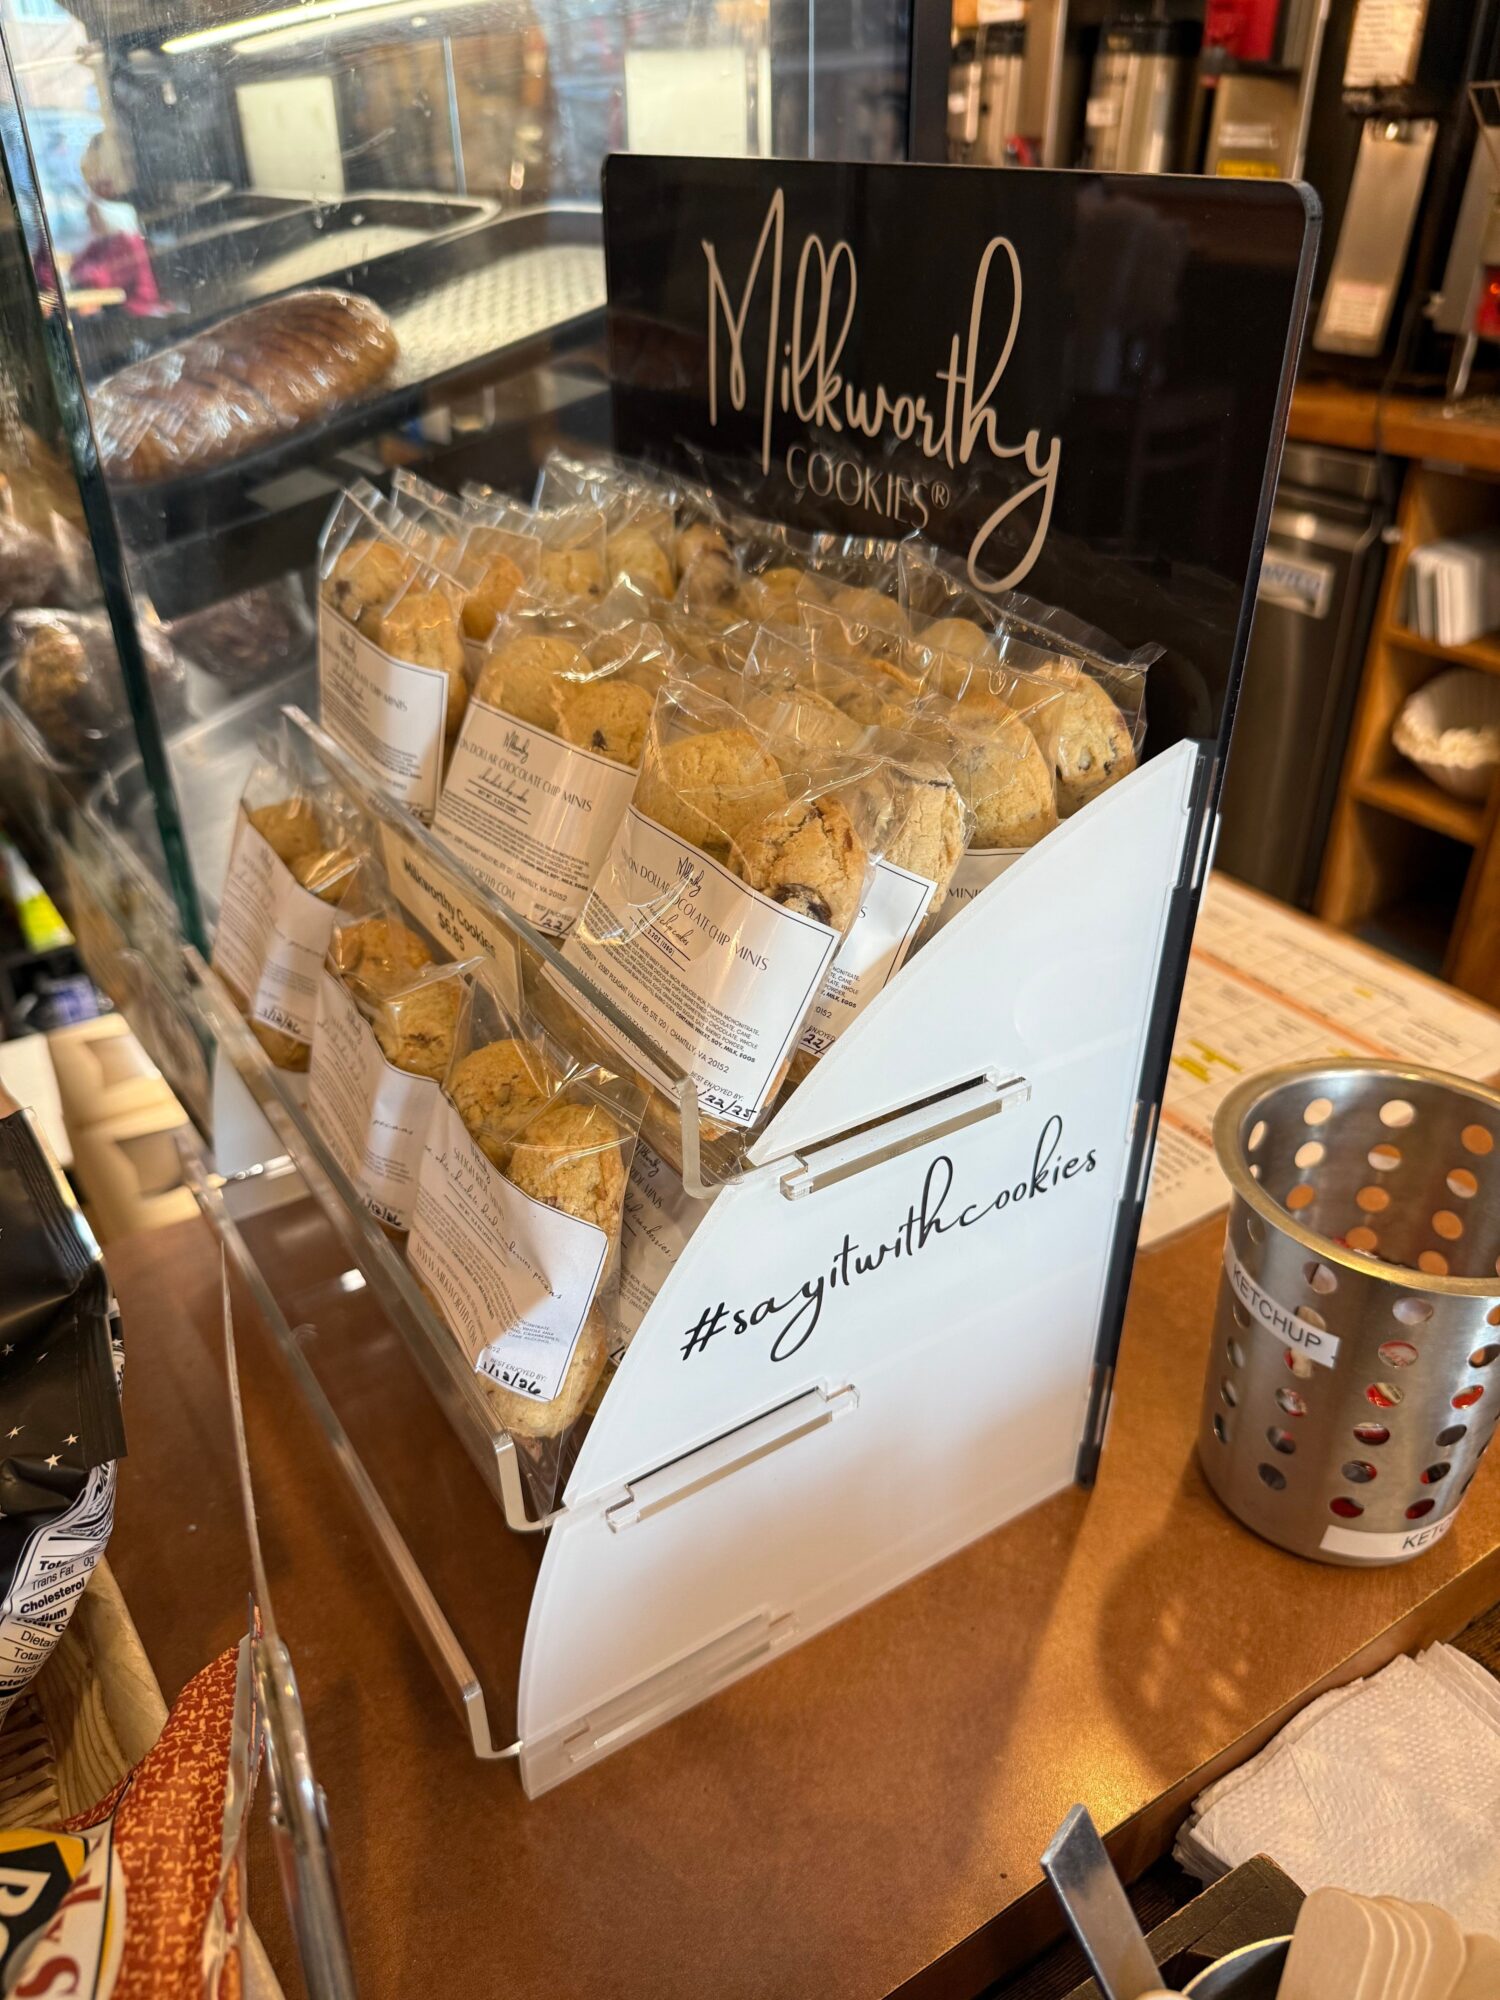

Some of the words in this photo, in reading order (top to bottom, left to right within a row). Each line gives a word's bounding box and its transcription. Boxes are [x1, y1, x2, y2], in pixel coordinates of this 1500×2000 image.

[702, 187, 1061, 593] Milkworthy
[498, 758, 542, 789] CHOCOLATE
[542, 780, 561, 797] CHIP
[562, 791, 593, 812] MINIS
[708, 925, 731, 946] CHIP
[735, 939, 770, 971] MINIS
[826, 991, 841, 1002] MILK,
[841, 998, 857, 1009] EGGS
[627, 989, 642, 1007] VALLEY
[649, 1010, 659, 1022] STE
[669, 1028, 697, 1055] CHANTILLY,
[698, 1050, 707, 1062] VA
[708, 1057, 730, 1074] 20152
[736, 1028, 752, 1040] CANE
[739, 1036, 758, 1050] WHOLE
[710, 1037, 724, 1049] SOY,
[723, 1045, 739, 1057] MILK,
[739, 1051, 756, 1063] EGGS
[703, 1079, 733, 1097] ENJOYED
[732, 1091, 745, 1102] BY:
[680, 1114, 1097, 1362] #sayitwithcookies
[1233, 1263, 1322, 1347] KETCHUP
[483, 1361, 542, 1395] 1/12/26
[535, 1372, 547, 1383] BY:
[32, 1574, 57, 1590] Trans
[59, 1564, 74, 1578] Fat
[20, 1577, 85, 1614] Cholesterol
[14, 1646, 42, 1661] Total
